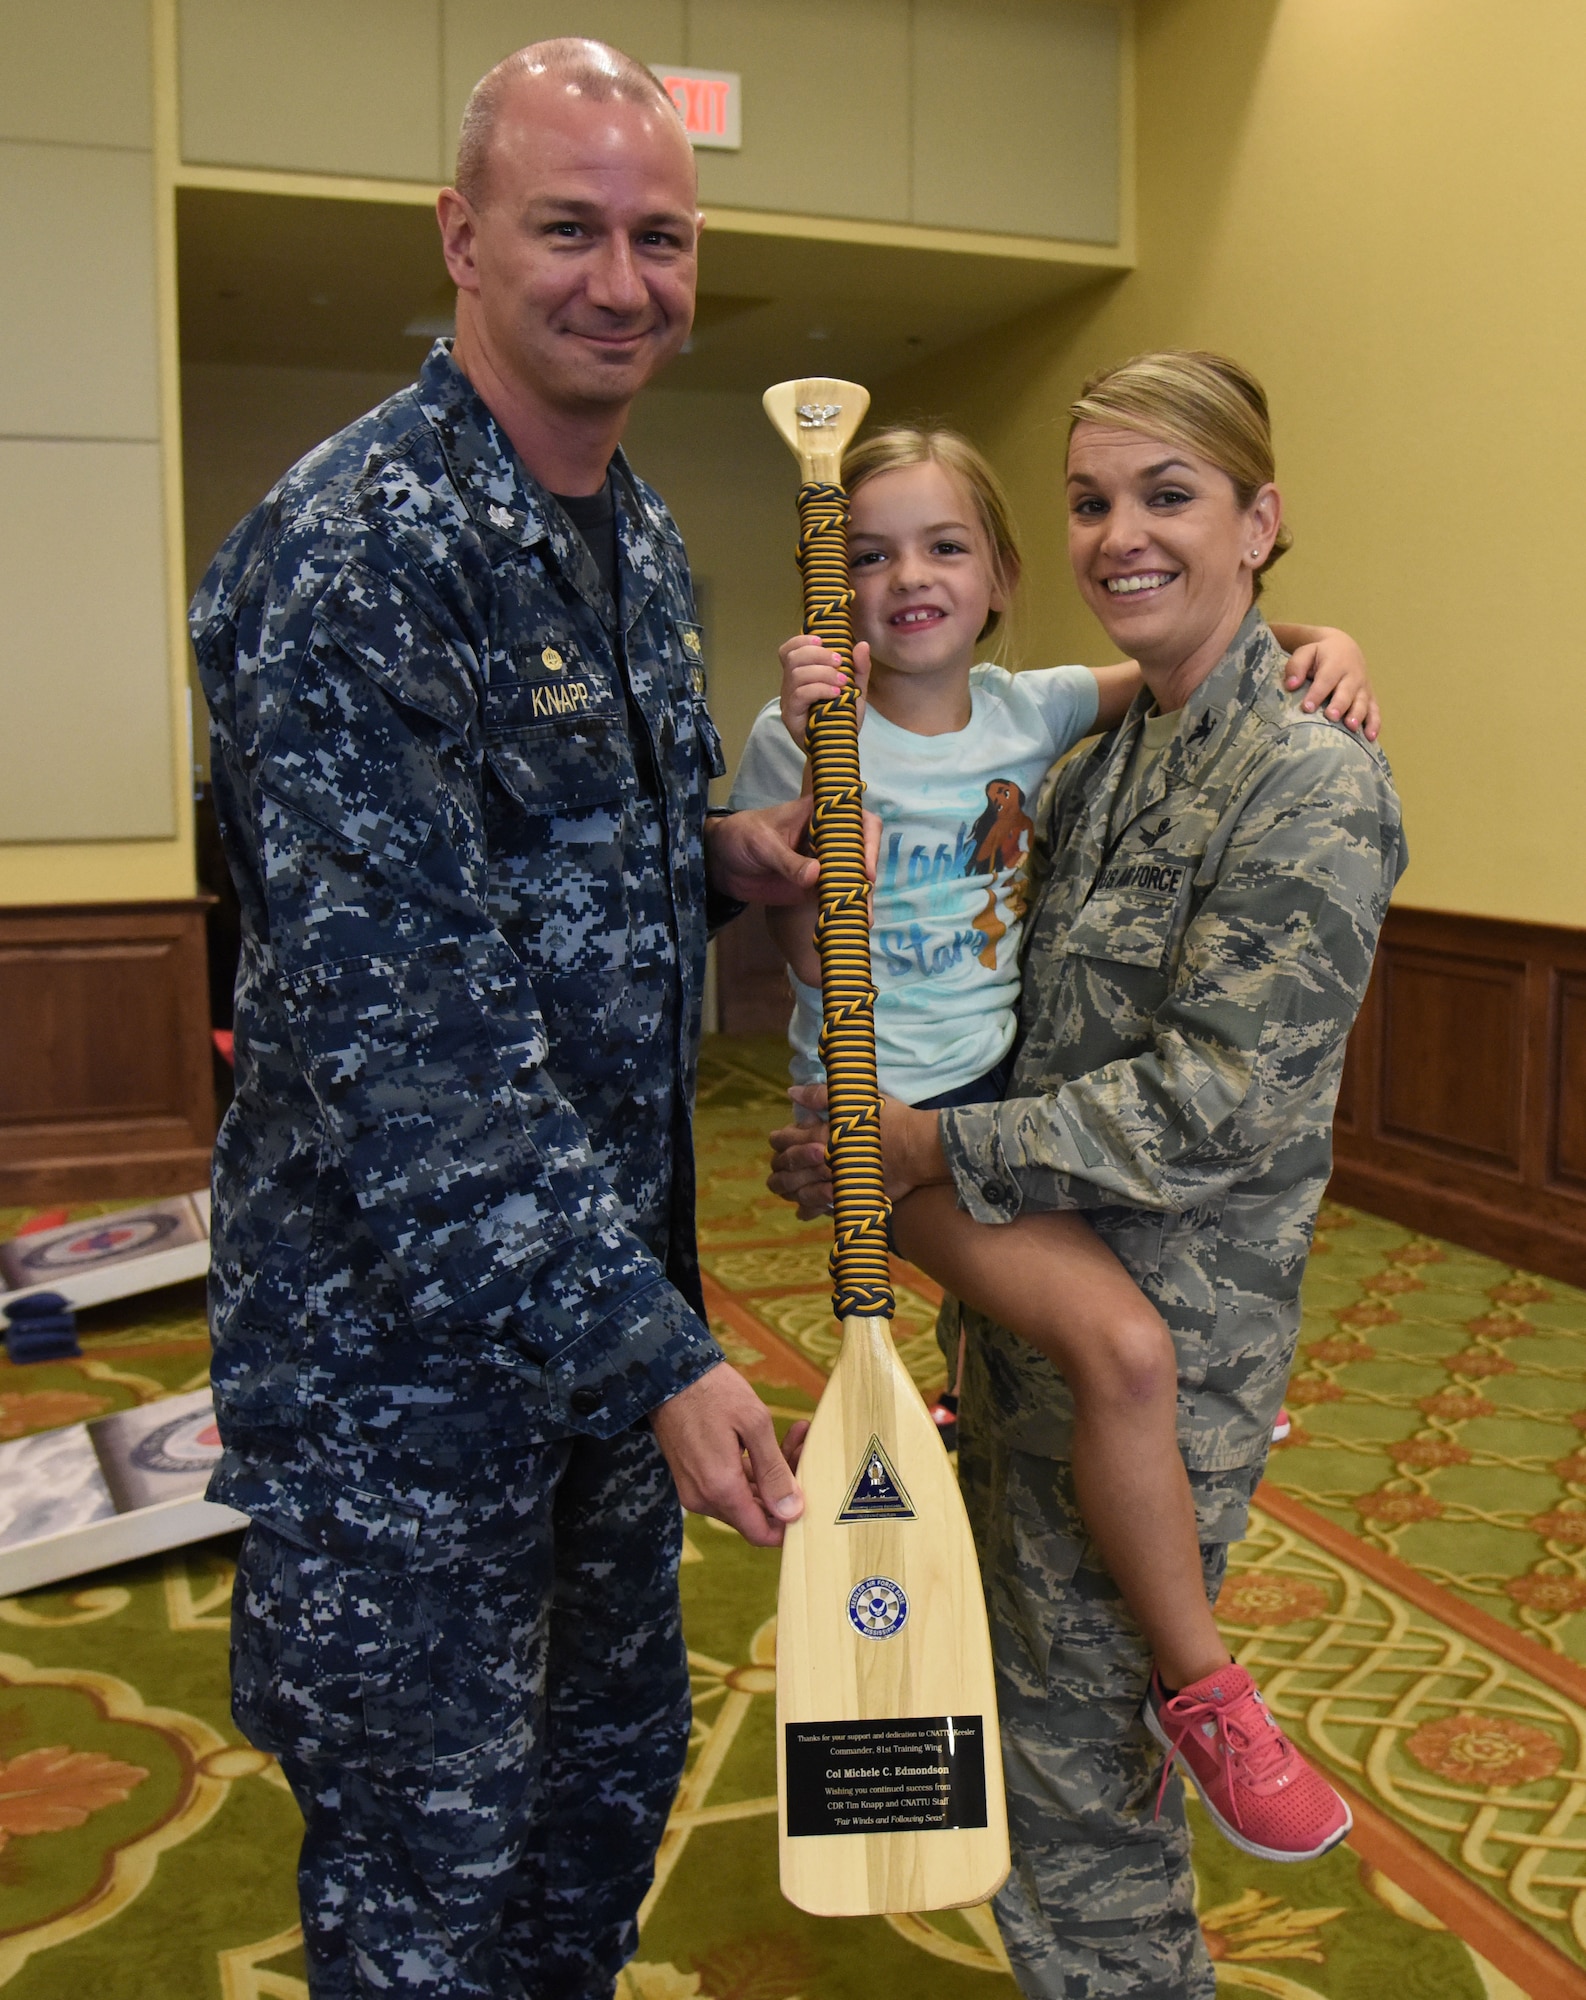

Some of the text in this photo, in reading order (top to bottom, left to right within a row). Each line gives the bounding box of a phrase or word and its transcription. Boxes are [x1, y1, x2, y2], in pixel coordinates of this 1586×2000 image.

[531, 682, 590, 717] KNAPP
[1131, 865, 1182, 893] FORCE
[797, 1735, 820, 1743] Thanks
[832, 1734, 846, 1742] your
[847, 1733, 871, 1741] support
[886, 1731, 917, 1739] dedication
[876, 1744, 892, 1754] 81st
[893, 1744, 923, 1754] Training
[924, 1743, 942, 1753] Wing
[826, 1765, 950, 1779] Col Michele C. Edmondson
[825, 1787, 854, 1796] Wishing
[855, 1787, 868, 1795] you
[870, 1784, 904, 1794] continued
[934, 1782, 951, 1791] from
[827, 1802, 844, 1810] CDR
[845, 1801, 860, 1810] Tim
[861, 1800, 884, 1810] Knapp
[900, 1798, 930, 1807] CNATTU
[932, 1797, 950, 1806] Staff
[852, 1816, 874, 1825] Winds
[890, 1815, 924, 1824] Following
